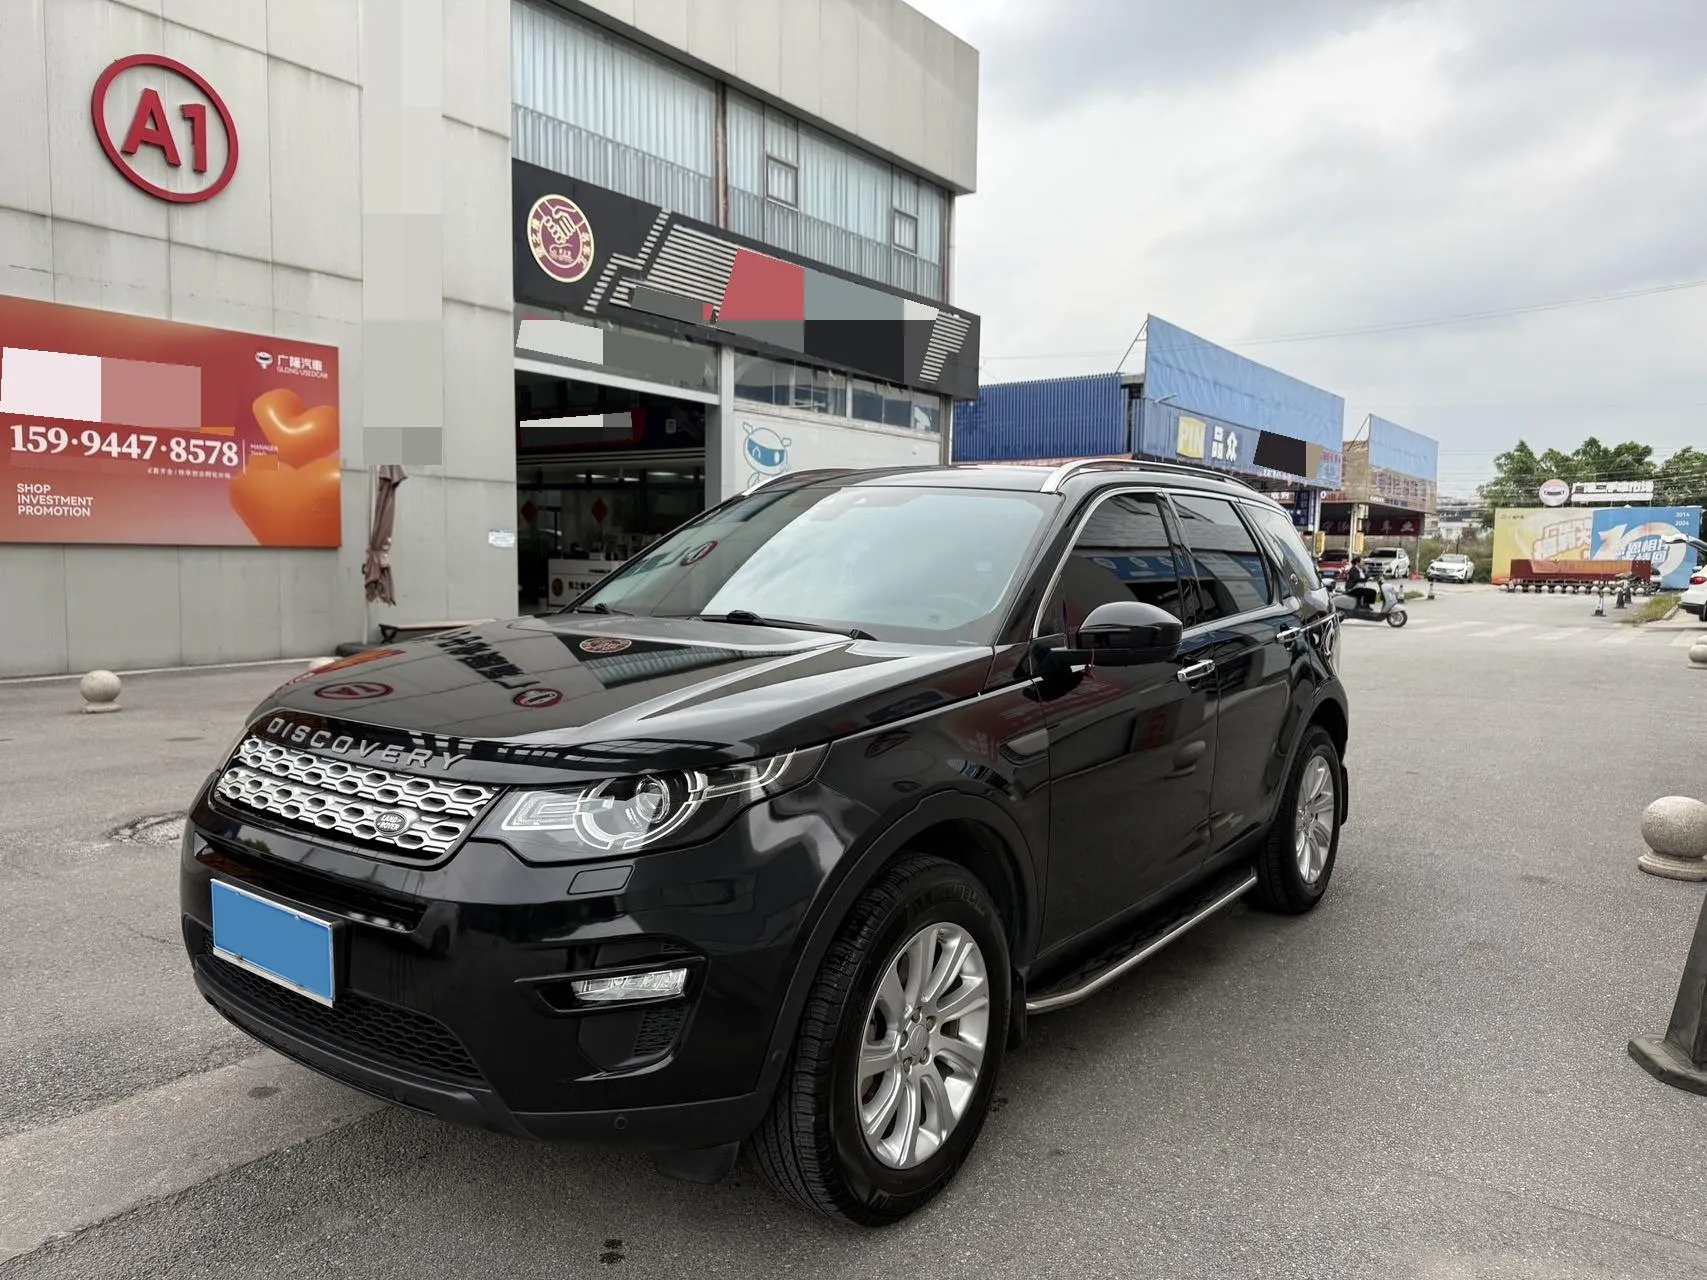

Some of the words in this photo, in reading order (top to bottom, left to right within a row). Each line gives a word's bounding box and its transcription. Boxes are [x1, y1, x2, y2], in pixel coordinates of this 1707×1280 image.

[120, 87, 207, 174] A1
[1211, 425, 1238, 462] 品众
[16, 483, 51, 494] SHOP
[17, 494, 94, 506] INVESTMENT
[17, 505, 91, 516] PROMOTION
[266, 717, 467, 771] DISCOVERY
